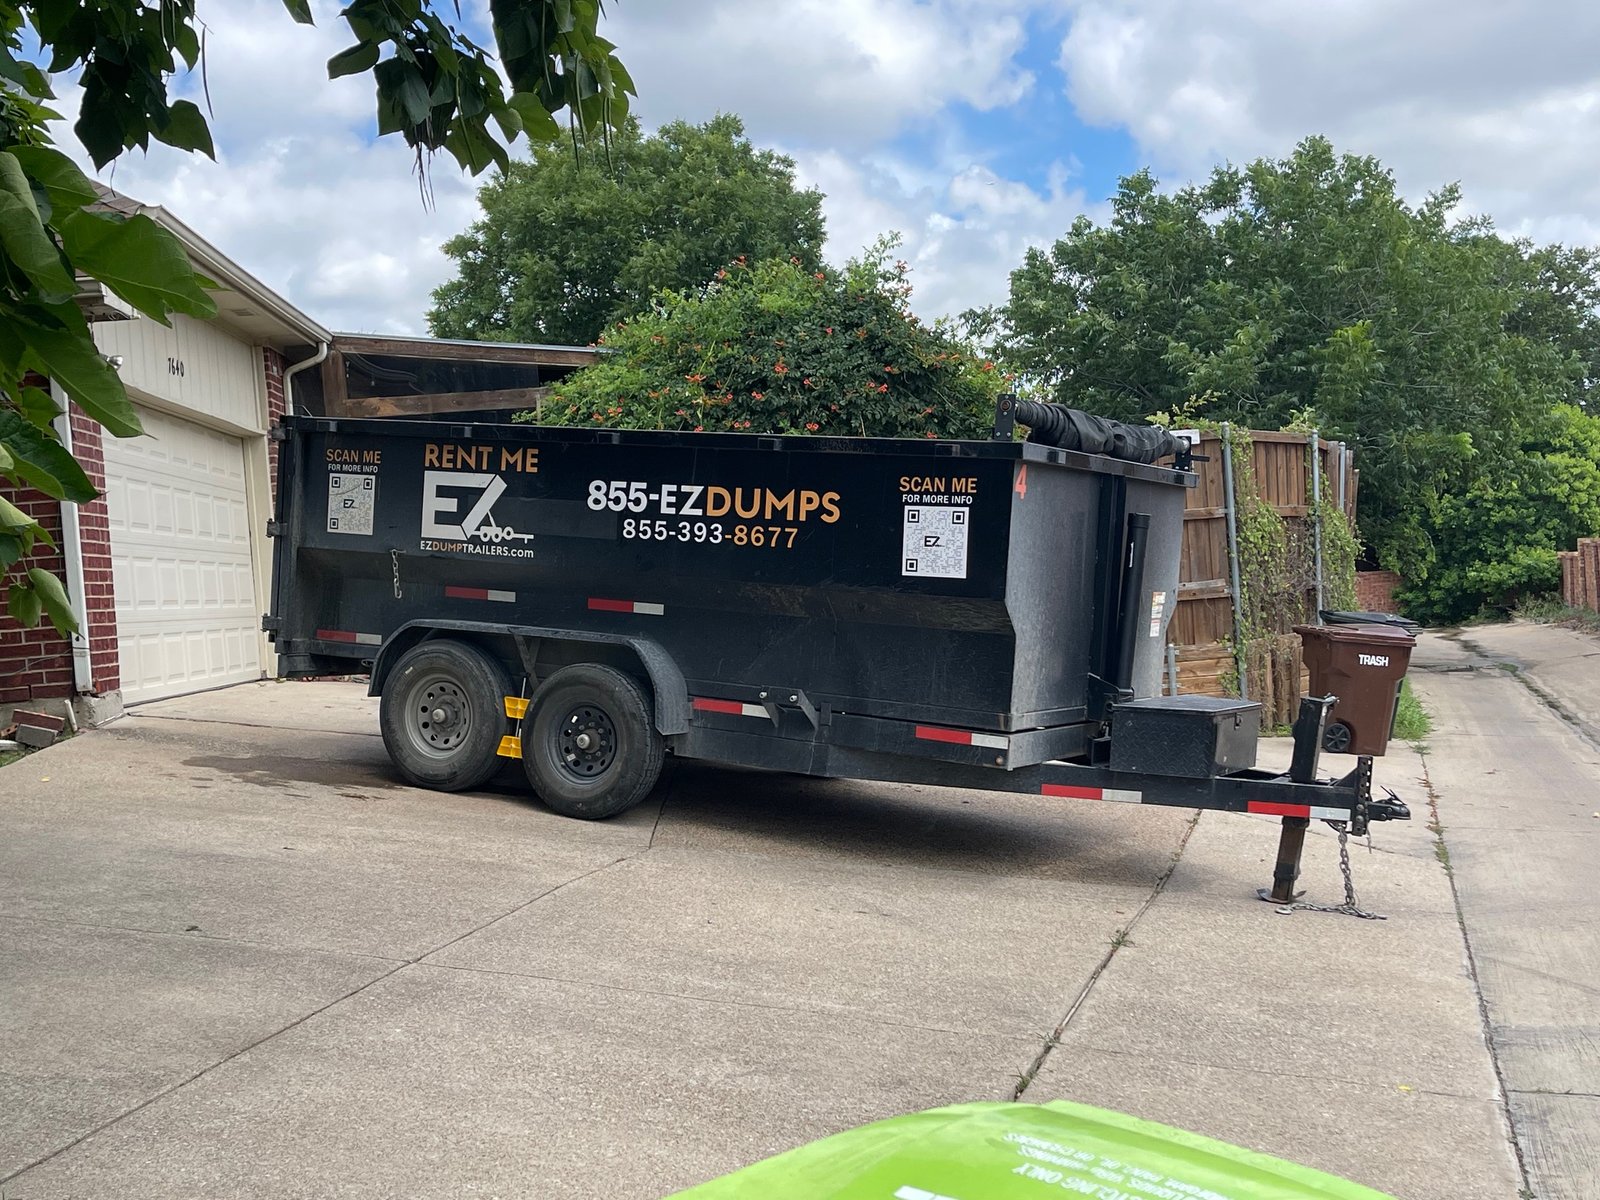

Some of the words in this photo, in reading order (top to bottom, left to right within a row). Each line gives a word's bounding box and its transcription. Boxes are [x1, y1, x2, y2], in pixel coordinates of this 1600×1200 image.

[168, 357, 185, 378] 7640
[326, 448, 359, 463] SCAN
[363, 450, 382, 464] ME
[424, 443, 493, 471] RENT
[500, 446, 539, 473] ME
[328, 463, 341, 472] FOR
[342, 464, 361, 473] MORE
[362, 465, 378, 473] INFO
[899, 476, 946, 493] SCAN
[951, 477, 978, 493] ME
[1014, 463, 1028, 500] 4
[421, 470, 508, 541] EZ
[586, 479, 841, 524] 855-EZDUMPS
[902, 493, 920, 503] FOR
[922, 494, 949, 504] MORE
[951, 495, 973, 504] INFO
[622, 518, 798, 549] 855-393-8677
[924, 535, 940, 547] EZ
[420, 540, 534, 558] EZDUMPTRAILERS.com
[1358, 653, 1389, 667] TRASH
[1011, 1162, 1063, 1184] ONLY
